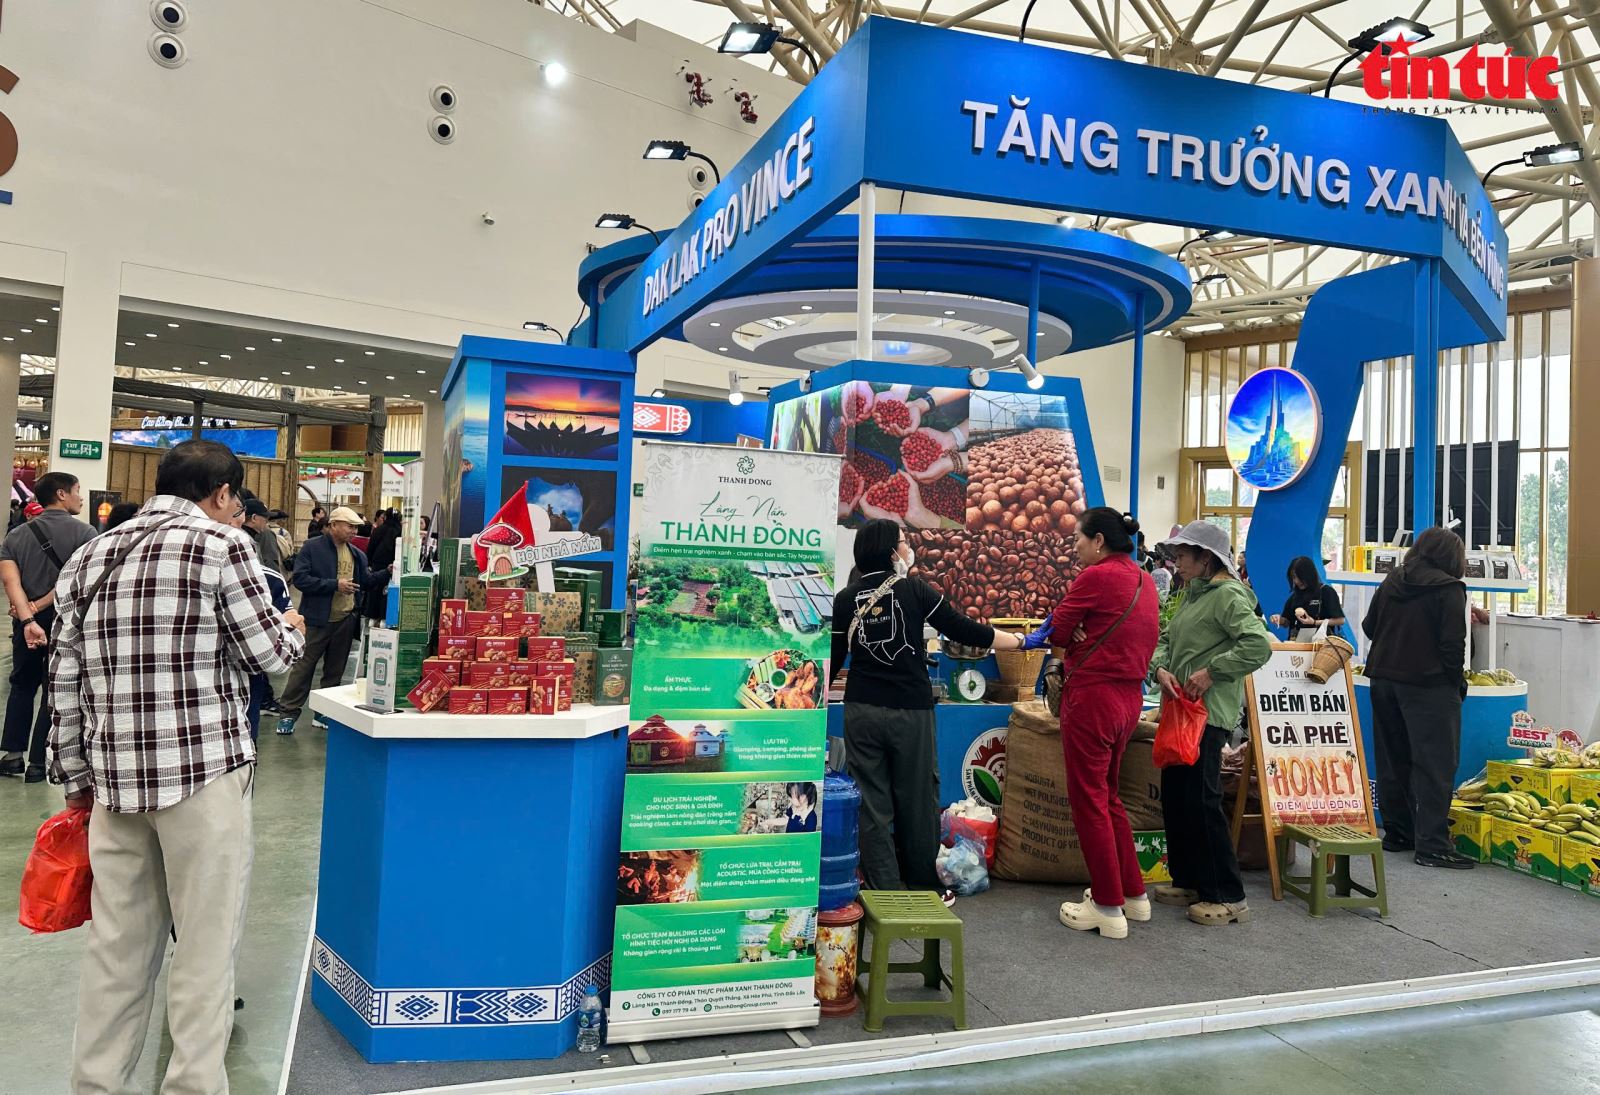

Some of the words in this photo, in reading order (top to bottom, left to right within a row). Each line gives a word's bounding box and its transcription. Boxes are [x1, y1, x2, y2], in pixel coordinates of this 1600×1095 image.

[961, 95, 1119, 169] TĂNG
[1137, 125, 1351, 204] TRƯỞNG
[1364, 166, 1457, 230] XANH
[1456, 192, 1469, 249] VÀ
[642, 257, 671, 316] DAK
[670, 228, 703, 295] LAK
[701, 115, 815, 270] PROVINCE
[719, 476, 747, 484] THANH
[700, 491, 744, 521] Làng
[661, 518, 746, 544] THÀNH
[754, 520, 821, 547] ĐỒNG
[1260, 687, 1306, 712] ĐIỂM
[1309, 690, 1347, 712] BÁN
[1266, 722, 1299, 745] CÀ
[1304, 722, 1348, 744] PHÊ
[1512, 728, 1549, 741] BEST
[1272, 756, 1356, 796] HONEY
[1022, 826, 1056, 848] PRODUCT
